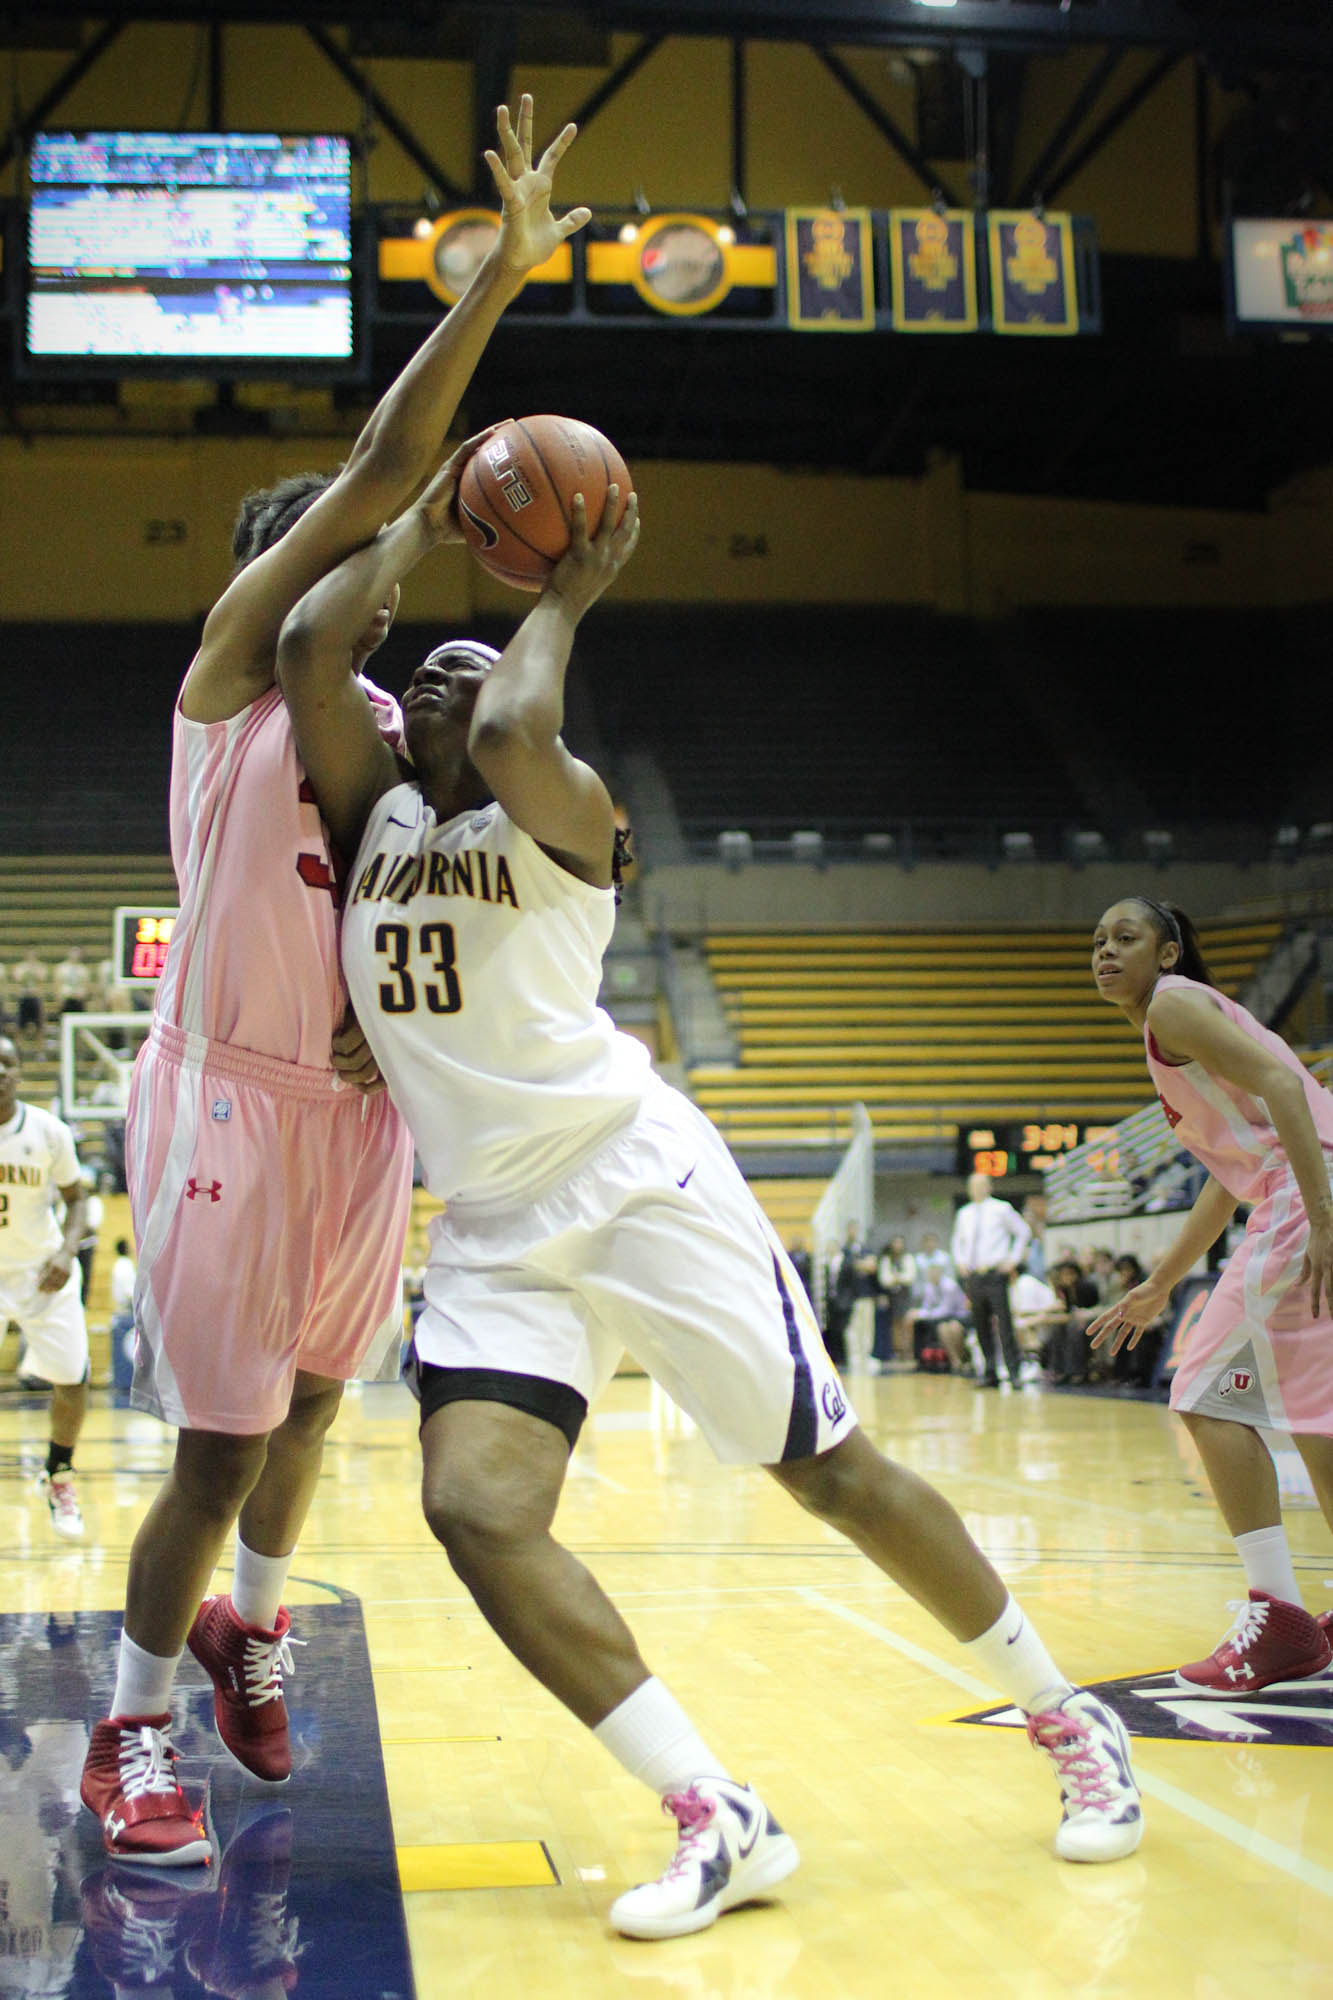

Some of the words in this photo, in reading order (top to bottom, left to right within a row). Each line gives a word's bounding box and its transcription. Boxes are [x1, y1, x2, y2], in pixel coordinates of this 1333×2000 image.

[374, 922, 463, 1015] 33
[822, 1377, 847, 1432] Cal
[1234, 1373, 1251, 1391] U
